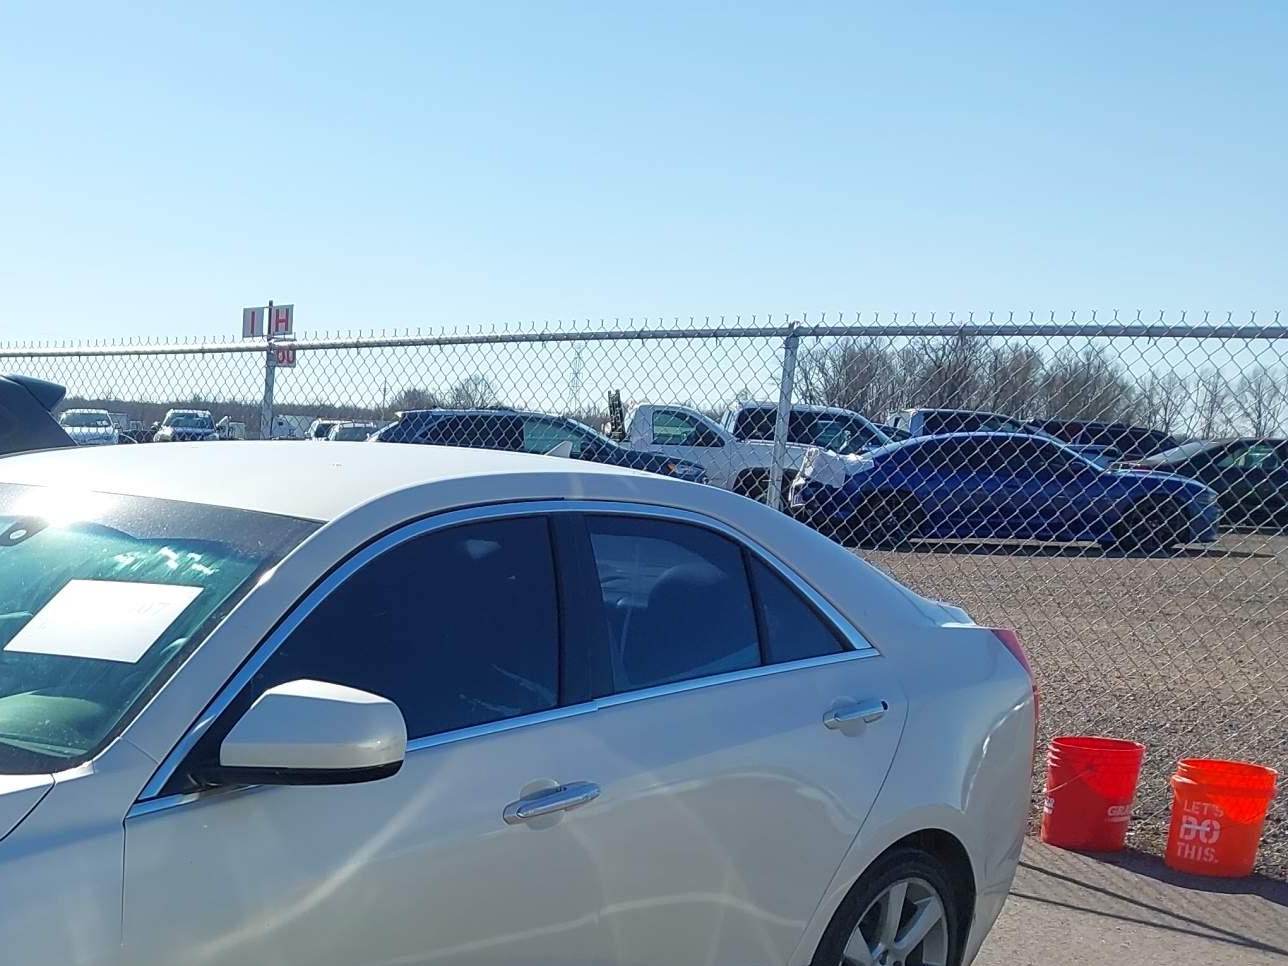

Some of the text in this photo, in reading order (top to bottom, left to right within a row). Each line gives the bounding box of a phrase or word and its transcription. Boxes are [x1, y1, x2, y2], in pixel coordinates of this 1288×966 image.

[275, 308, 289, 332] H
[1184, 800, 1225, 818] LET'S
[1180, 816, 1221, 844] DO
[1176, 844, 1219, 864] THIS.
